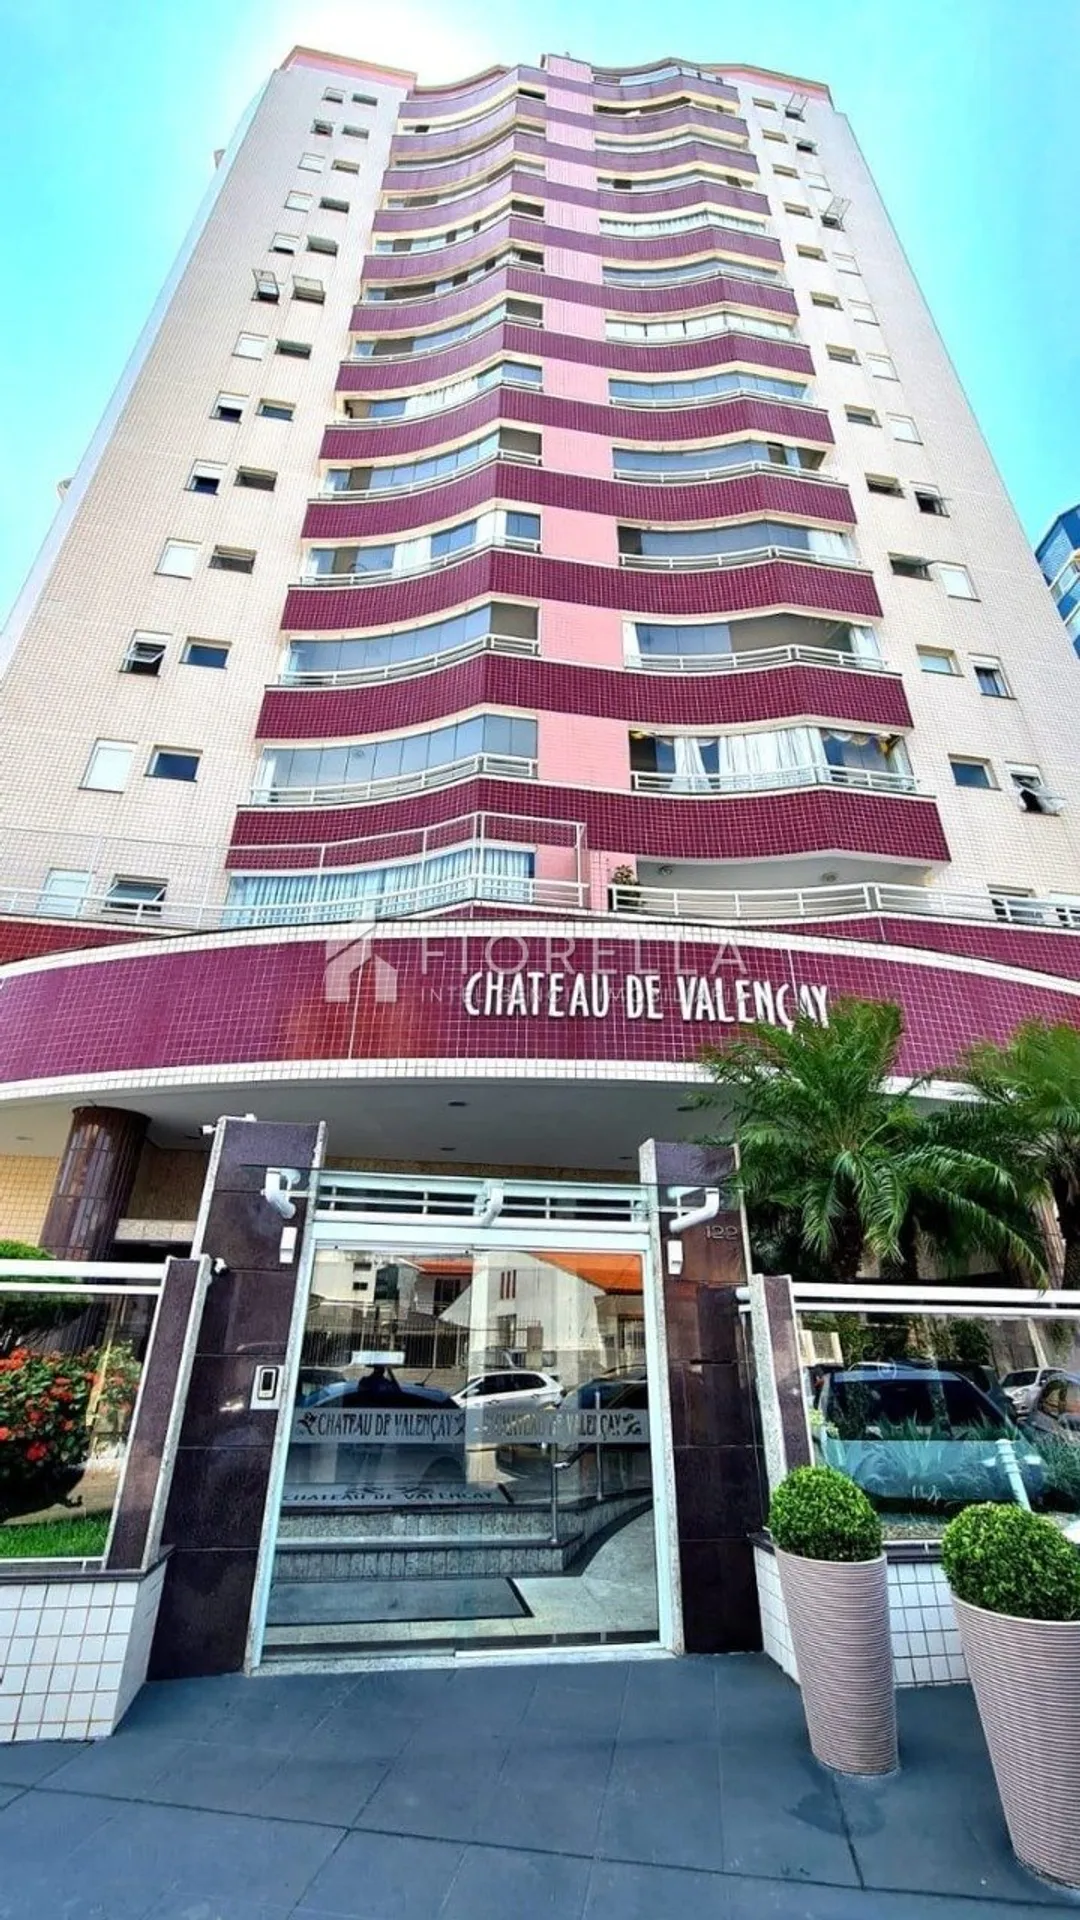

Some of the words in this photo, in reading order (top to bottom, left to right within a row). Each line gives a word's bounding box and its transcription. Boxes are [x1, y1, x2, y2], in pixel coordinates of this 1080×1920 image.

[464, 971, 609, 1018] CHATEAU
[626, 974, 664, 1020] DE
[677, 976, 829, 1034] VALENÇAY
[705, 1225, 738, 1239] 122
[317, 1412, 372, 1436] CHATEAU
[375, 1413, 392, 1436] DE
[395, 1412, 452, 1441] VALENÇAY
